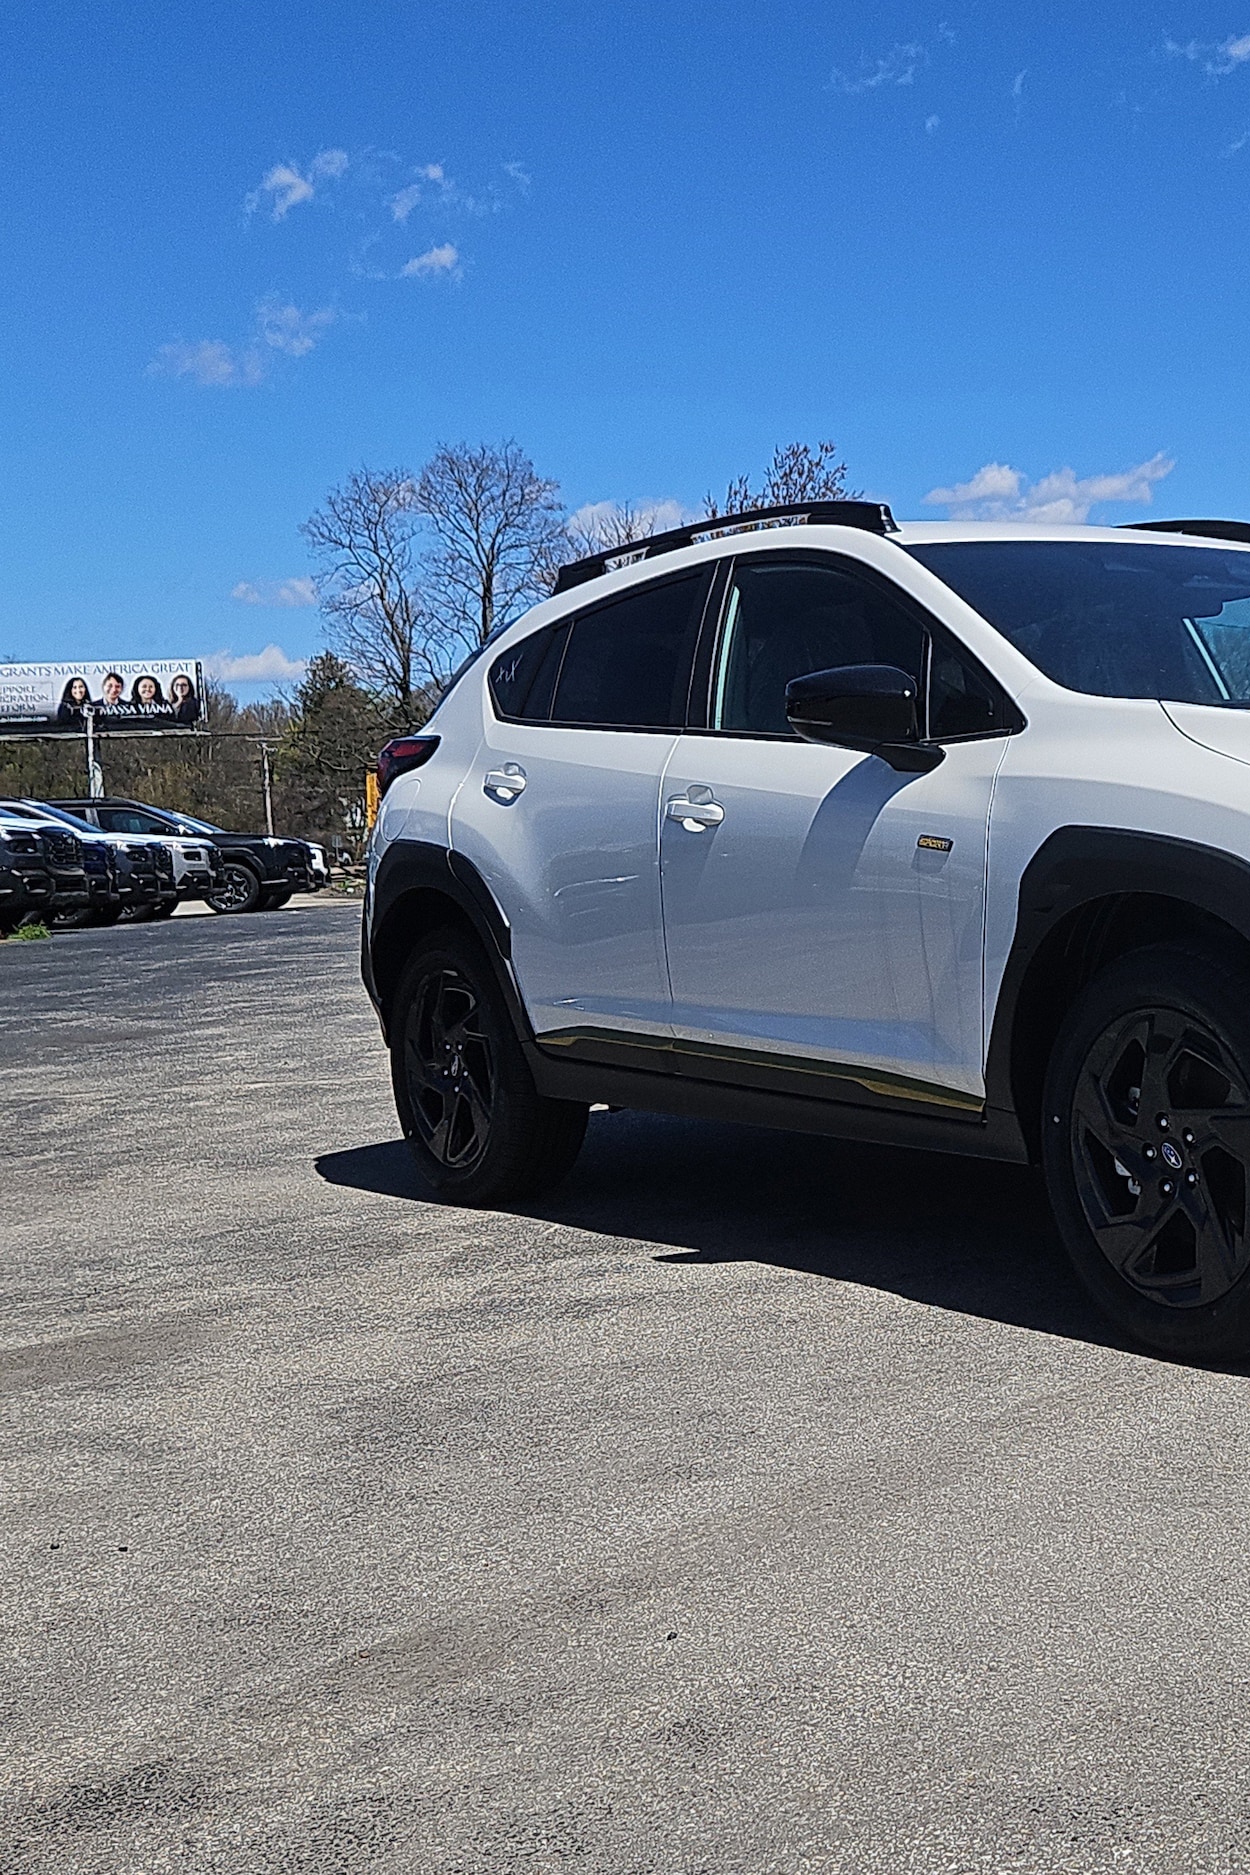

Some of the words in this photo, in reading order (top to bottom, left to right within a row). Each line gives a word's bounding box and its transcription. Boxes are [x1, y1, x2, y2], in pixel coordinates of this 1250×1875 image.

[54, 664, 90, 675] MAKE
[93, 662, 148, 674] AMERICA
[151, 661, 191, 673] GREAT
